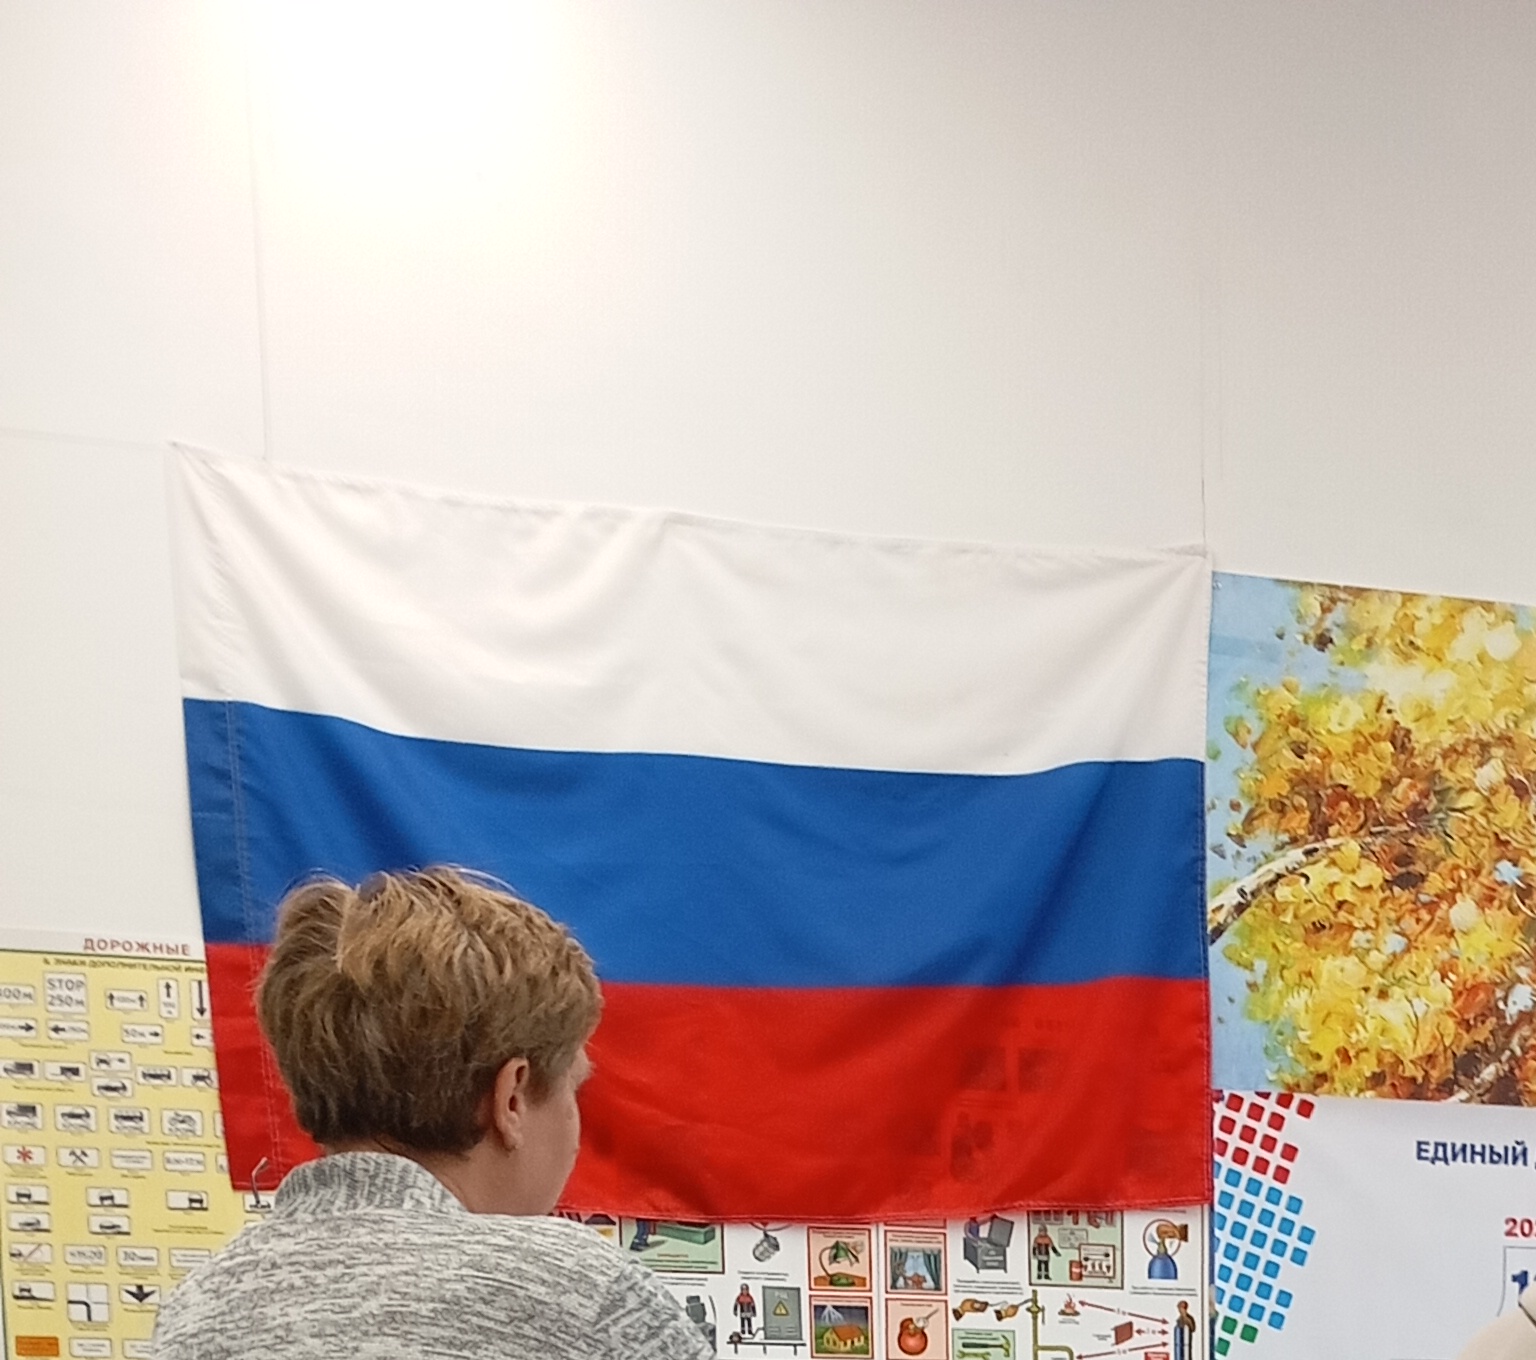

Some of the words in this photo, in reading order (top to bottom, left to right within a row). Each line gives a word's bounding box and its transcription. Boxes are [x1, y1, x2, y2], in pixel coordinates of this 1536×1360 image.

[83, 937, 191, 957] ДОРОЖНЫЕ
[47, 978, 85, 992] STOP
[1416, 1139, 1529, 1166] ЕДИНЫЙ
